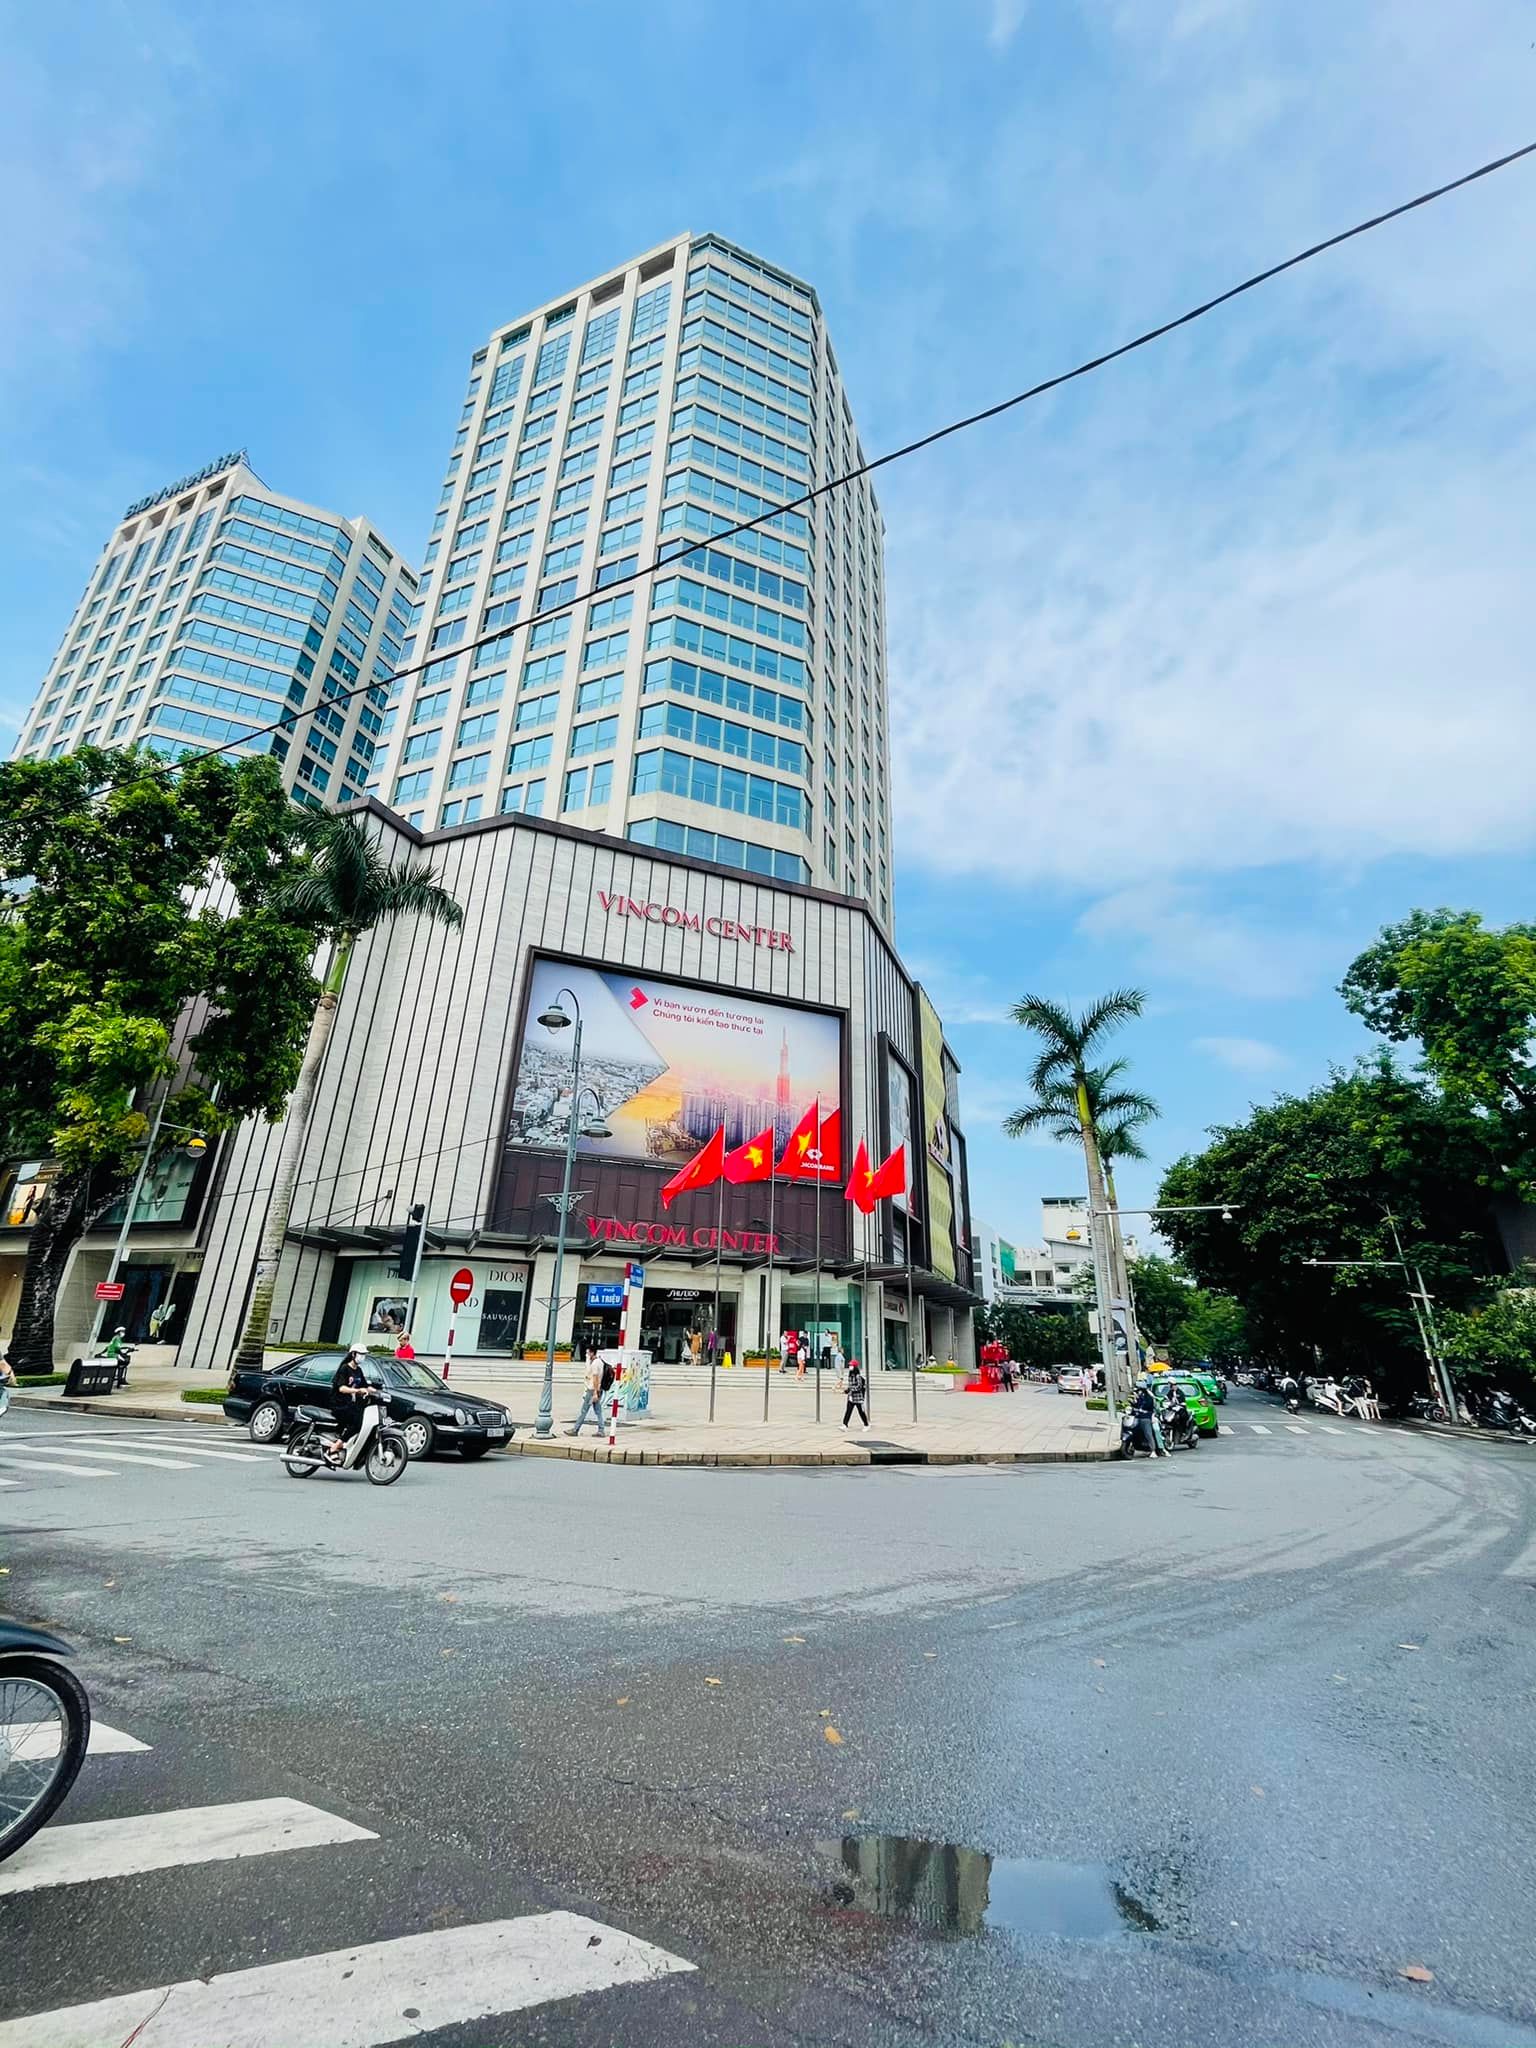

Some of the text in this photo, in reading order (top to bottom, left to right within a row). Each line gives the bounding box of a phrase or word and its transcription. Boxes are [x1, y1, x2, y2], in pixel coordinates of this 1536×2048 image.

[597, 891, 796, 954] VINCOM CENTER
[586, 1216, 781, 1255] VINCOM CENTER
[489, 1269, 524, 1284] DIOR
[481, 1312, 519, 1322] SAUVAGE
